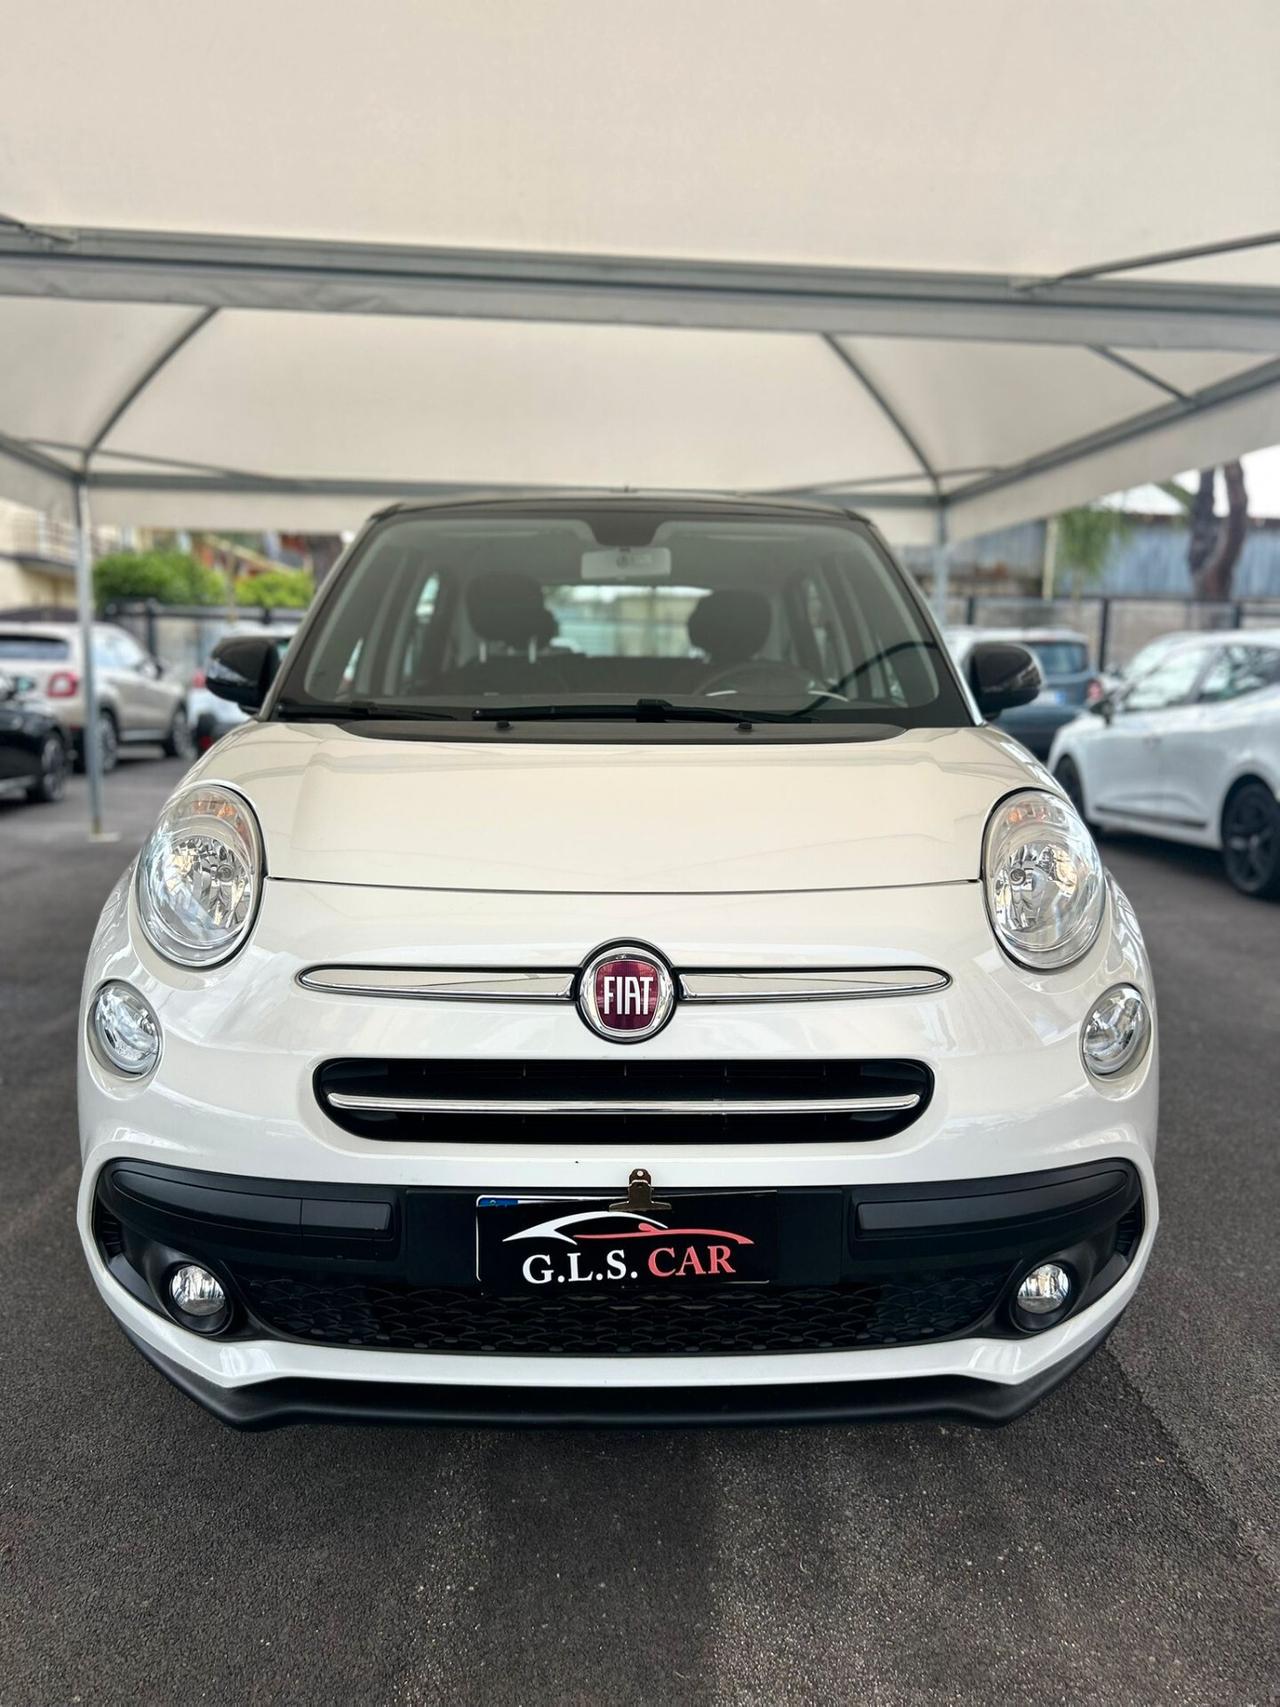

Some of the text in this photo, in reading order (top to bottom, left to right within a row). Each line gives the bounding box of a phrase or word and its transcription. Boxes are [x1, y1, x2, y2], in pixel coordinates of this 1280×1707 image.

[603, 976, 653, 1015] FIAT
[522, 1245, 736, 1284] G.L.S. CAR
